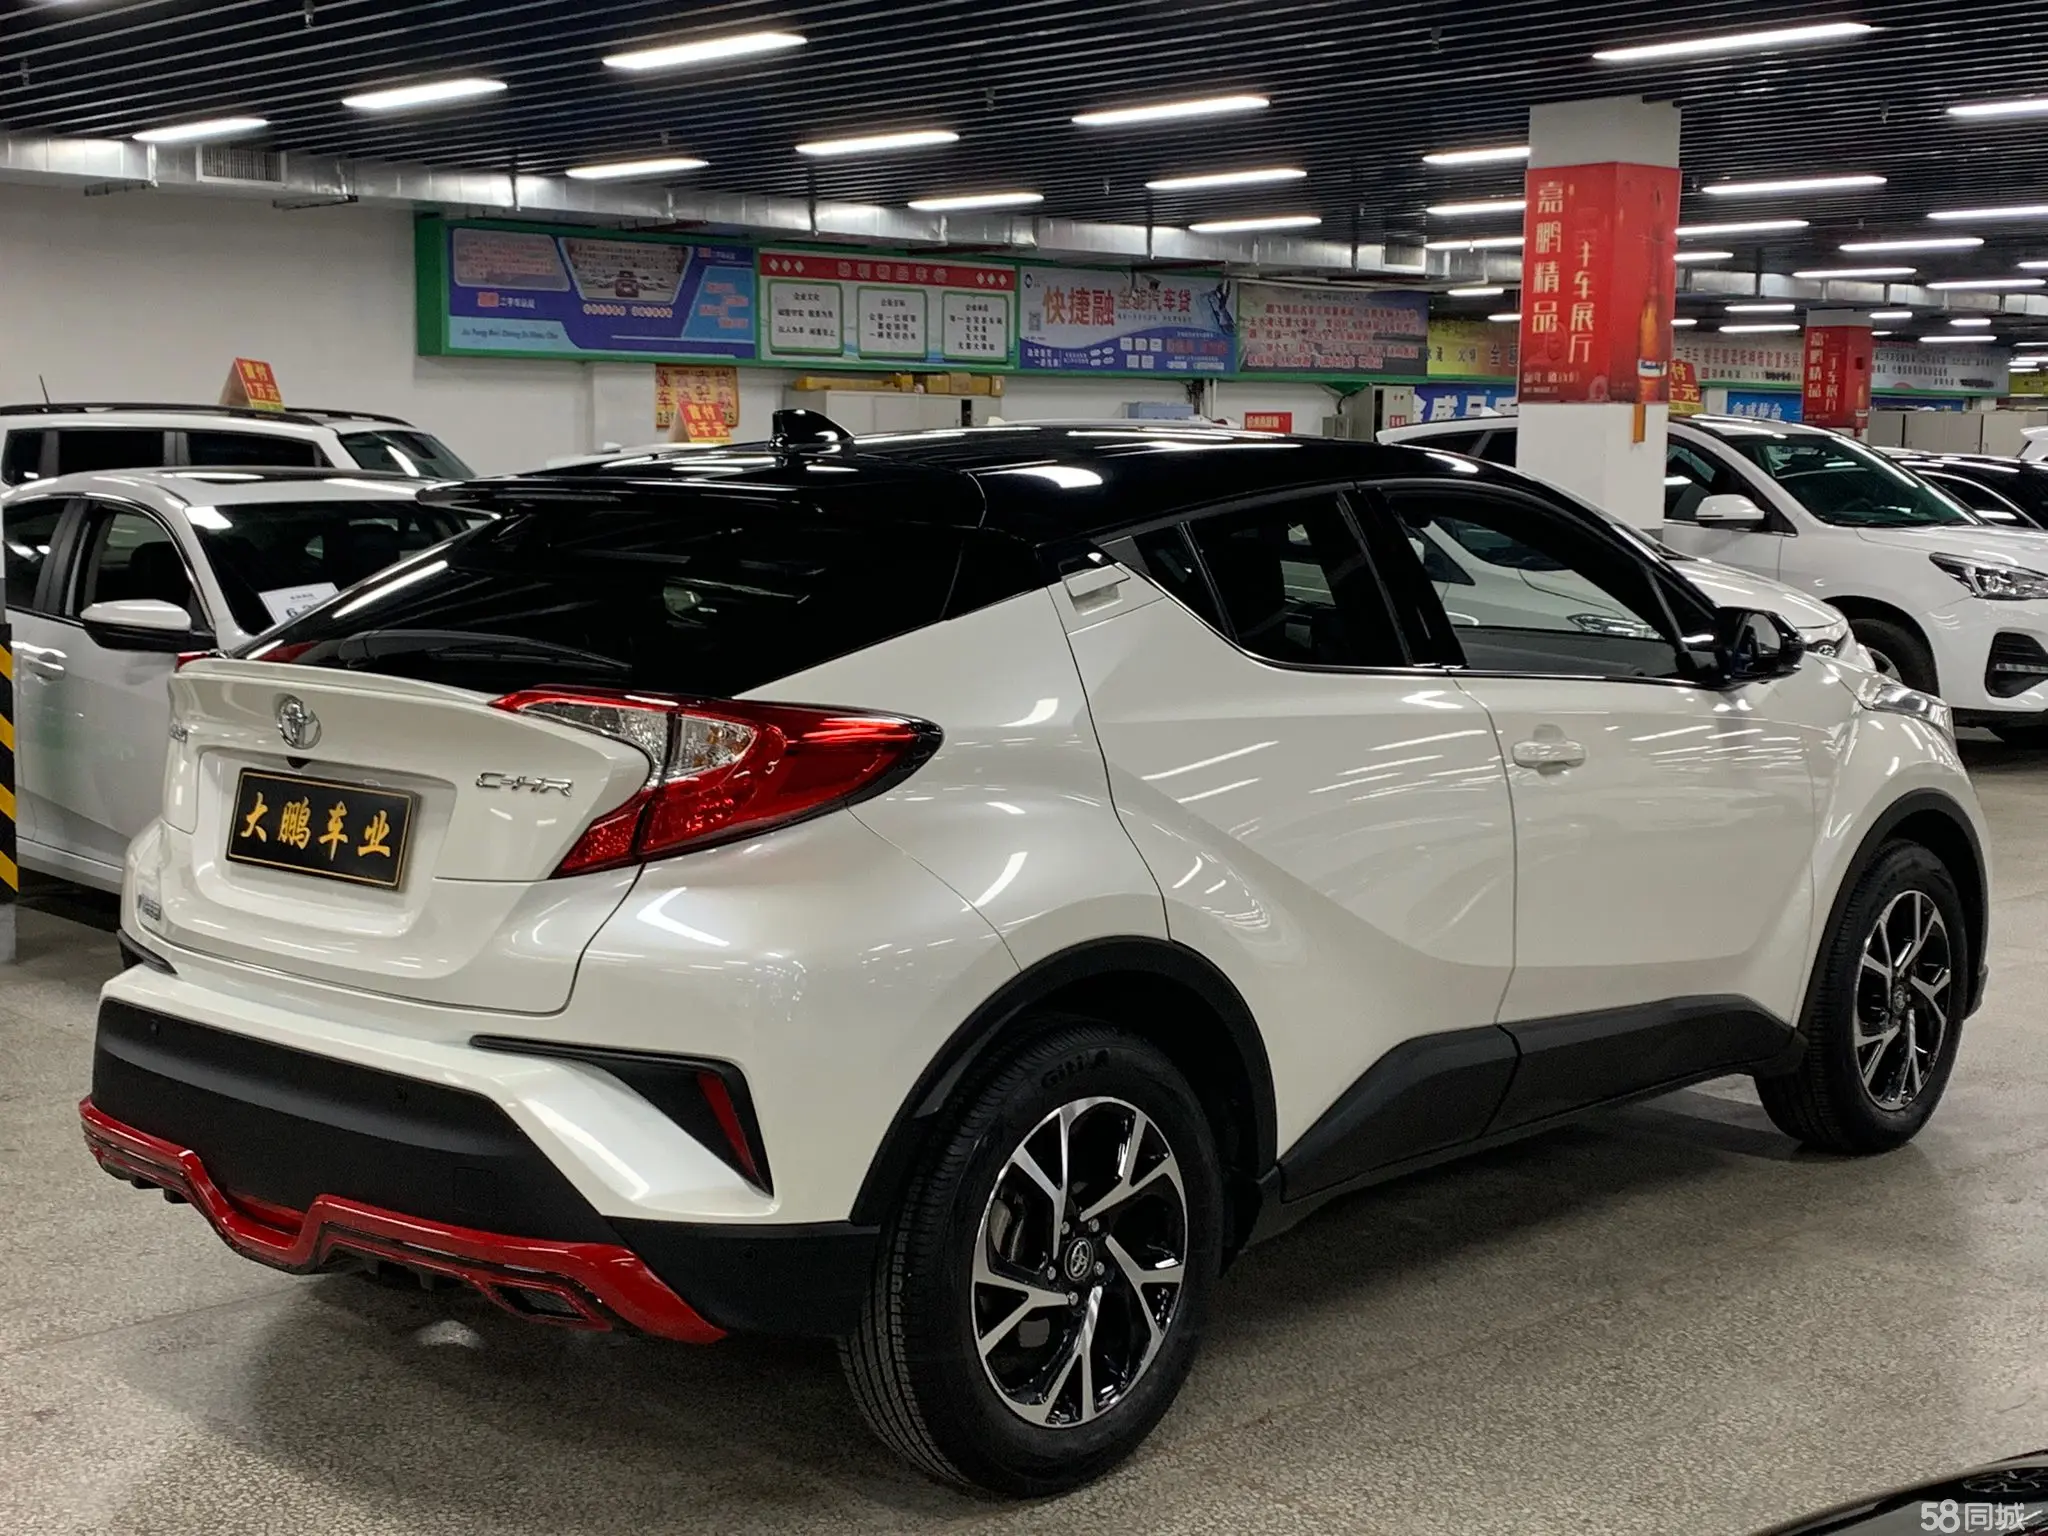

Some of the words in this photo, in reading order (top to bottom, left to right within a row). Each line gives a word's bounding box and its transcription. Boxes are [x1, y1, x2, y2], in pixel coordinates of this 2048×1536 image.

[1532, 181, 1564, 334] 嘉鹏精品
[1042, 286, 1115, 326] 快捷融
[475, 772, 575, 798] C-HR
[240, 792, 392, 862] 大鹏车业
